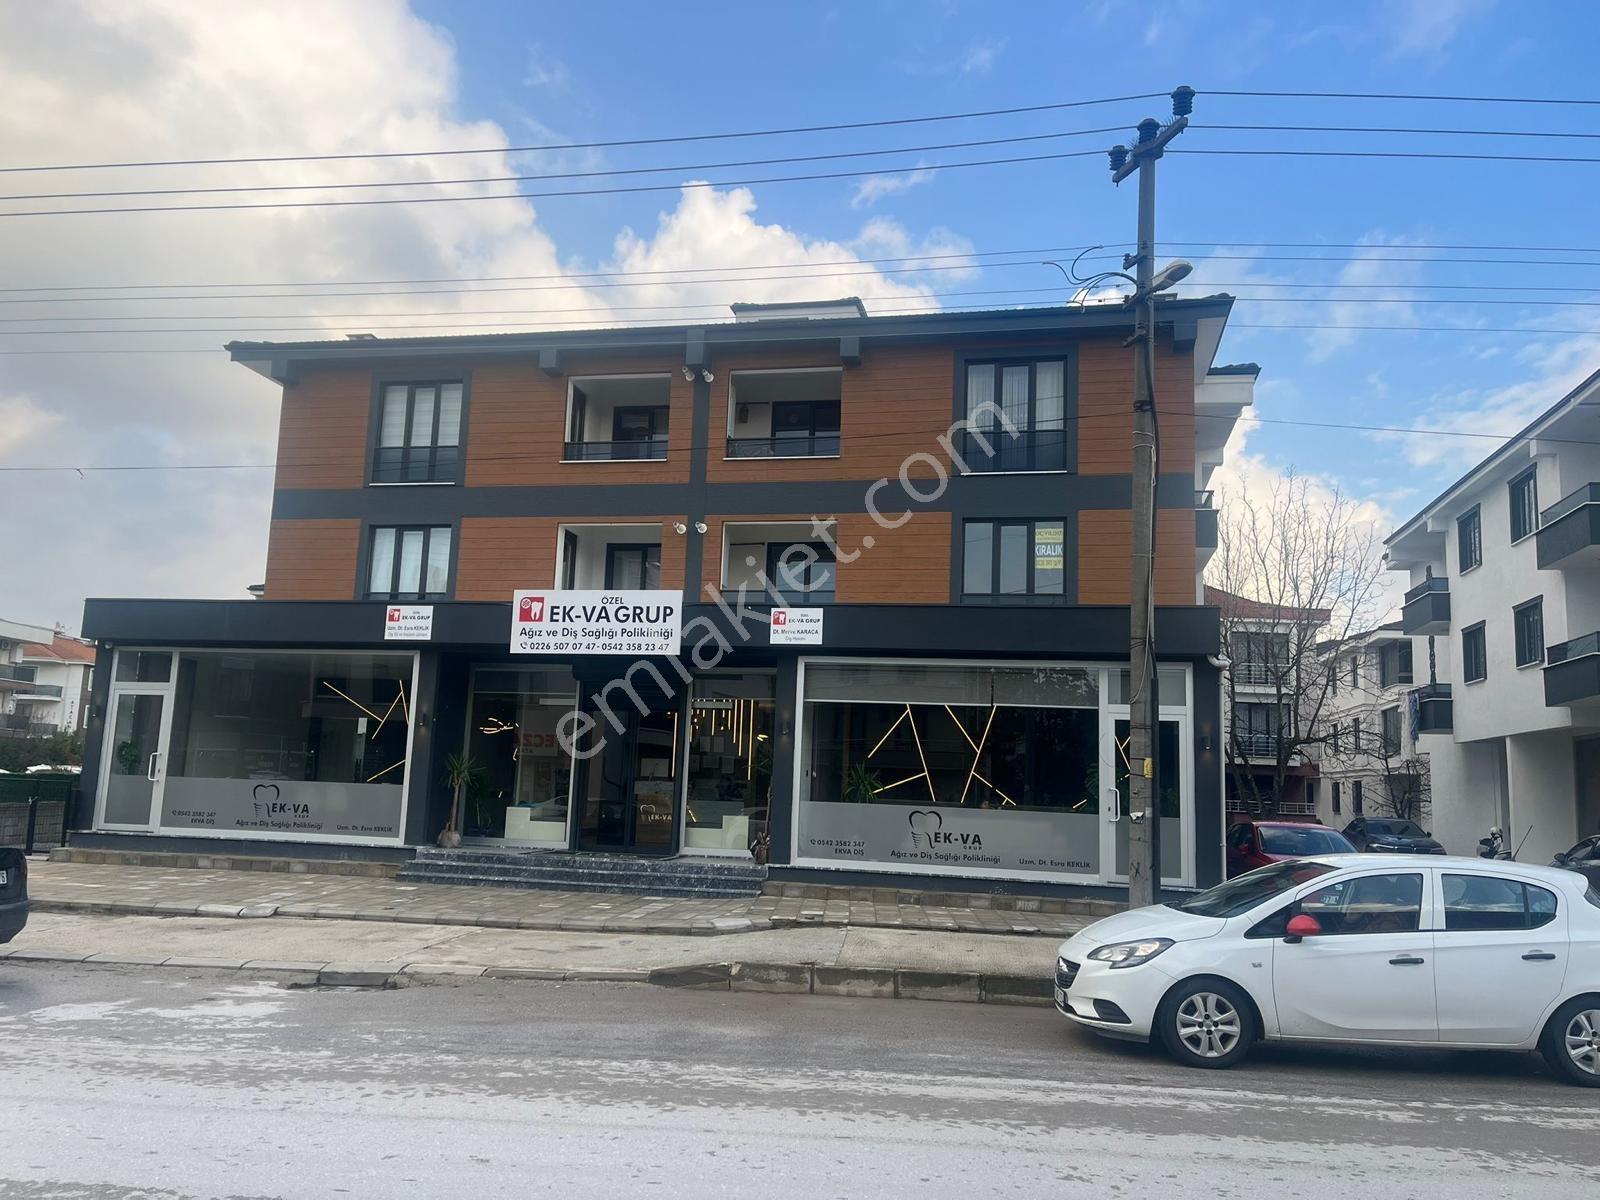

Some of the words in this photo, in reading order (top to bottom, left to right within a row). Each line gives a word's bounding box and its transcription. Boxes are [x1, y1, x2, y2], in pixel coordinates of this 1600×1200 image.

[601, 596, 624, 605] ÖZEL
[550, 605, 611, 623] EK-VA
[614, 605, 674, 623] GRUP
[519, 627, 542, 639] Ağız
[562, 627, 578, 639] Diş
[581, 627, 617, 640] Sağlığı
[621, 627, 673, 640] Polikliniği
[529, 642, 551, 650] 0226
[553, 642, 569, 650] 507
[572, 642, 583, 650] 07
[626, 643, 642, 651] 358
[645, 643, 656, 651] 23
[658, 643, 670, 651] 47
[271, 802, 309, 814] EK-VA
[934, 831, 982, 846] EK-VA
[890, 849, 907, 858] Ağız
[920, 851, 932, 860] Diş
[934, 851, 960, 861] Sağlığı
[963, 854, 1000, 864] Polikliniği
